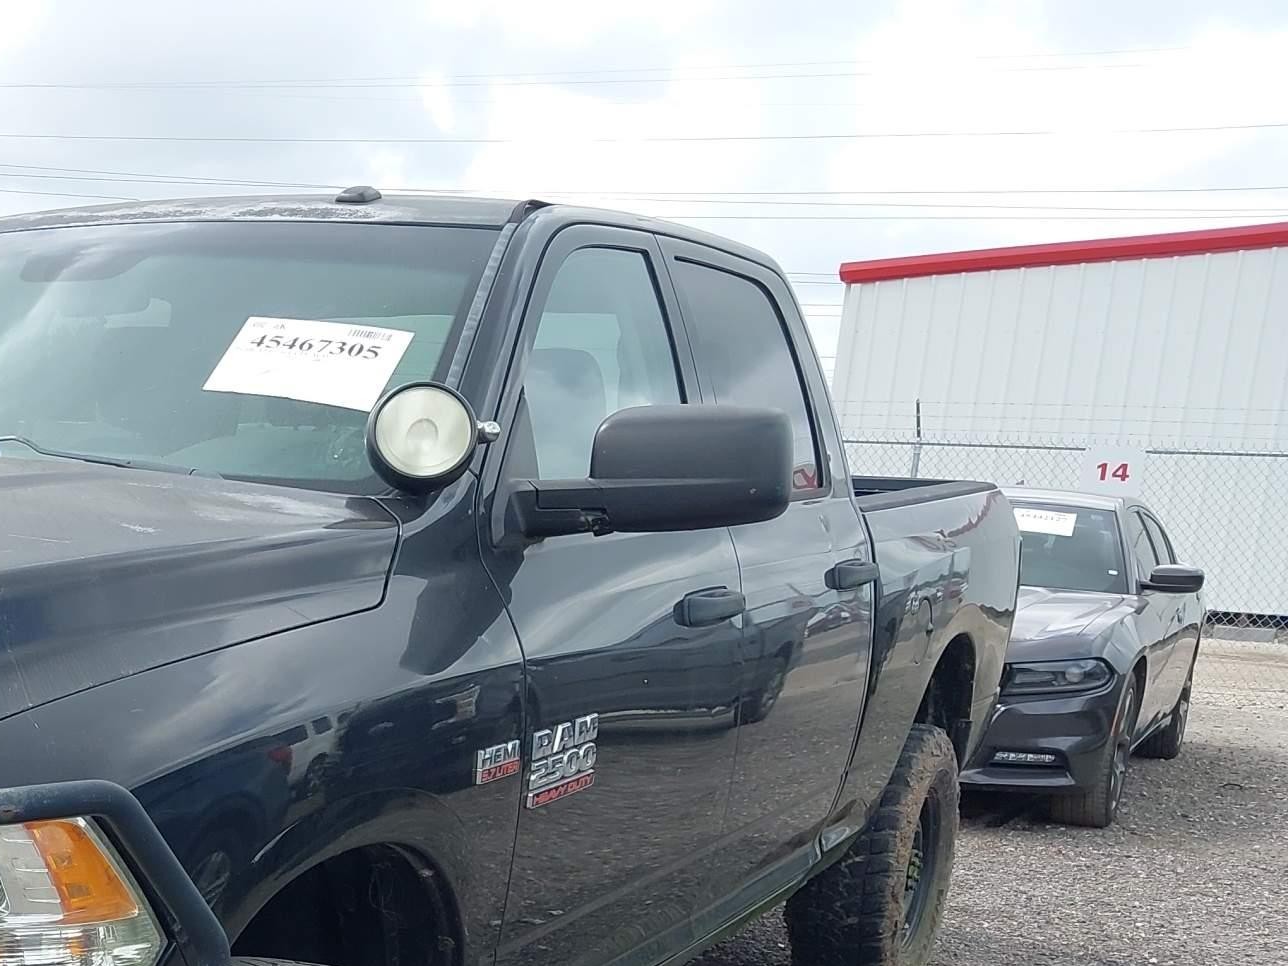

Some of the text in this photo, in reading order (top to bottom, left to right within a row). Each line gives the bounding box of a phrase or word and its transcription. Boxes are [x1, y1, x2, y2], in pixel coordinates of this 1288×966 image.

[250, 333, 382, 360] 45467305
[1096, 462, 1130, 482] 14
[532, 713, 598, 760] RAM
[478, 740, 520, 769] HEMI
[529, 743, 596, 790] 2500
[535, 775, 592, 805] HEAVY DUTY
